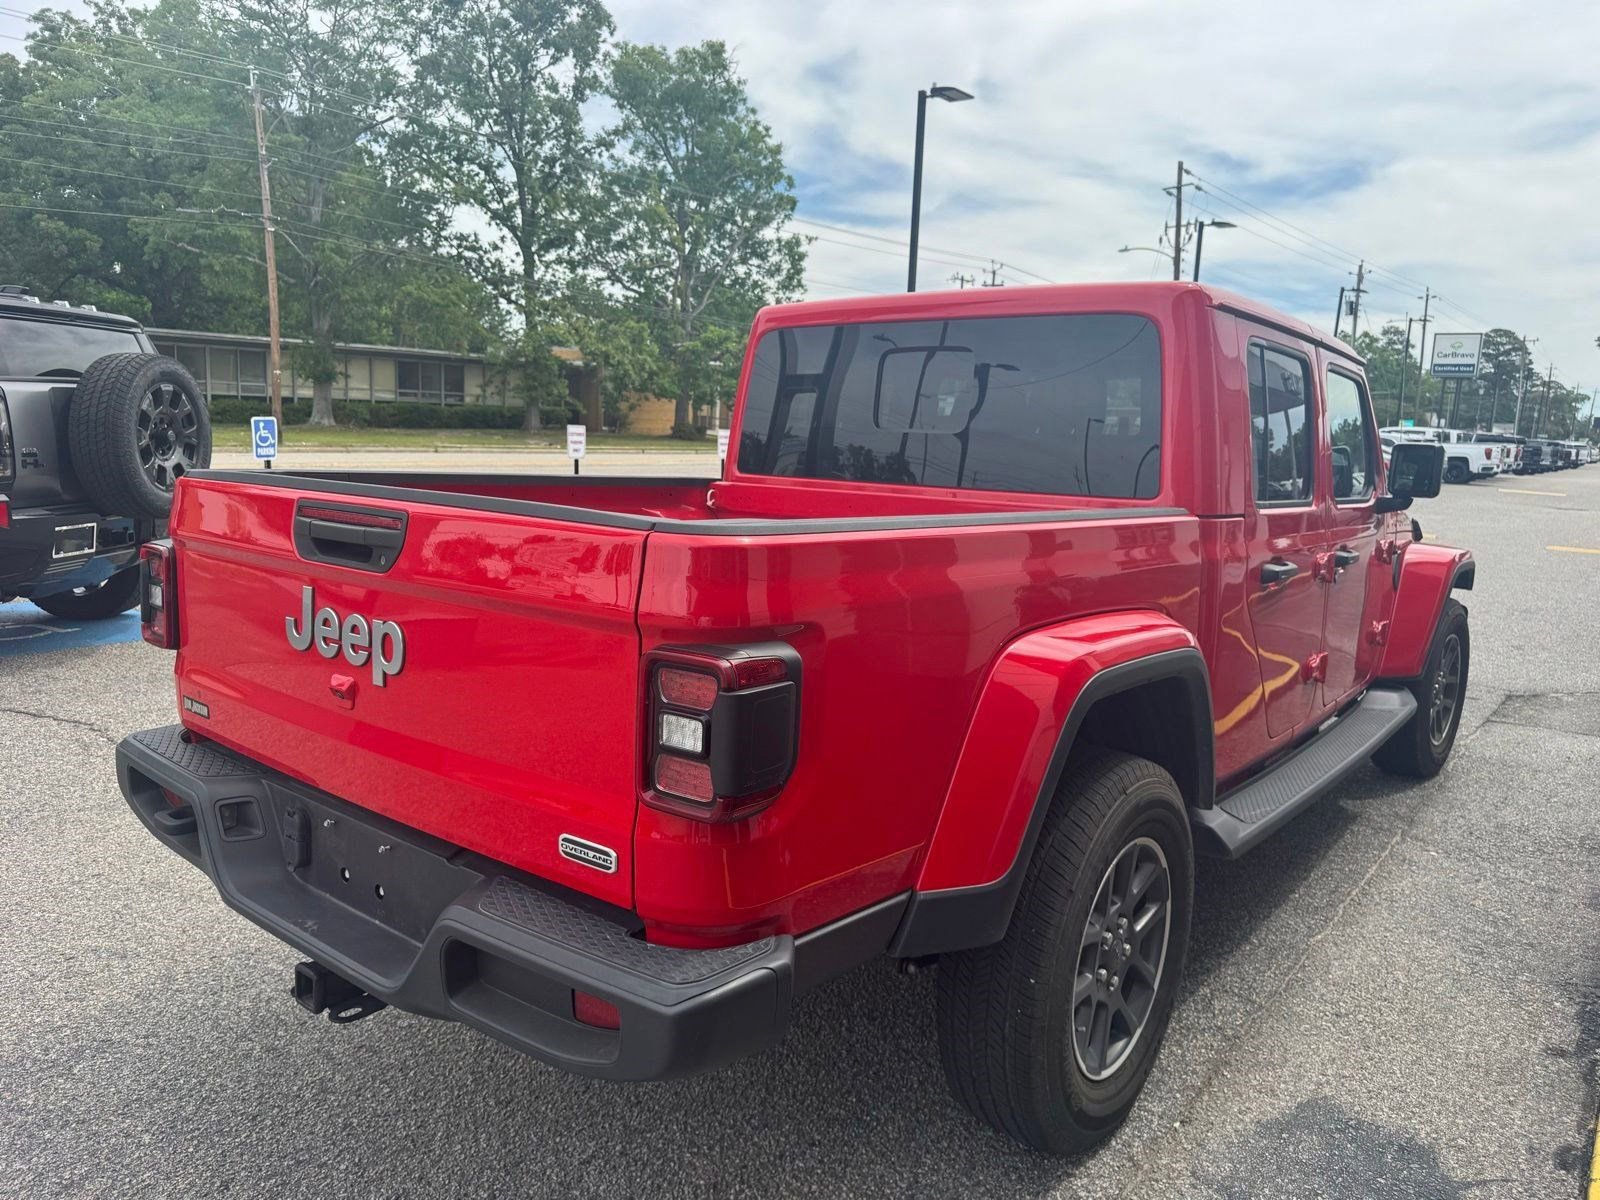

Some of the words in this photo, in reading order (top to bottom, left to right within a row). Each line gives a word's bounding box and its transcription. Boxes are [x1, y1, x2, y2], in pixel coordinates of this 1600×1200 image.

[1436, 351, 1475, 359] CarBravo
[285, 585, 404, 688] Jeep
[561, 843, 613, 865] OVERLAND
